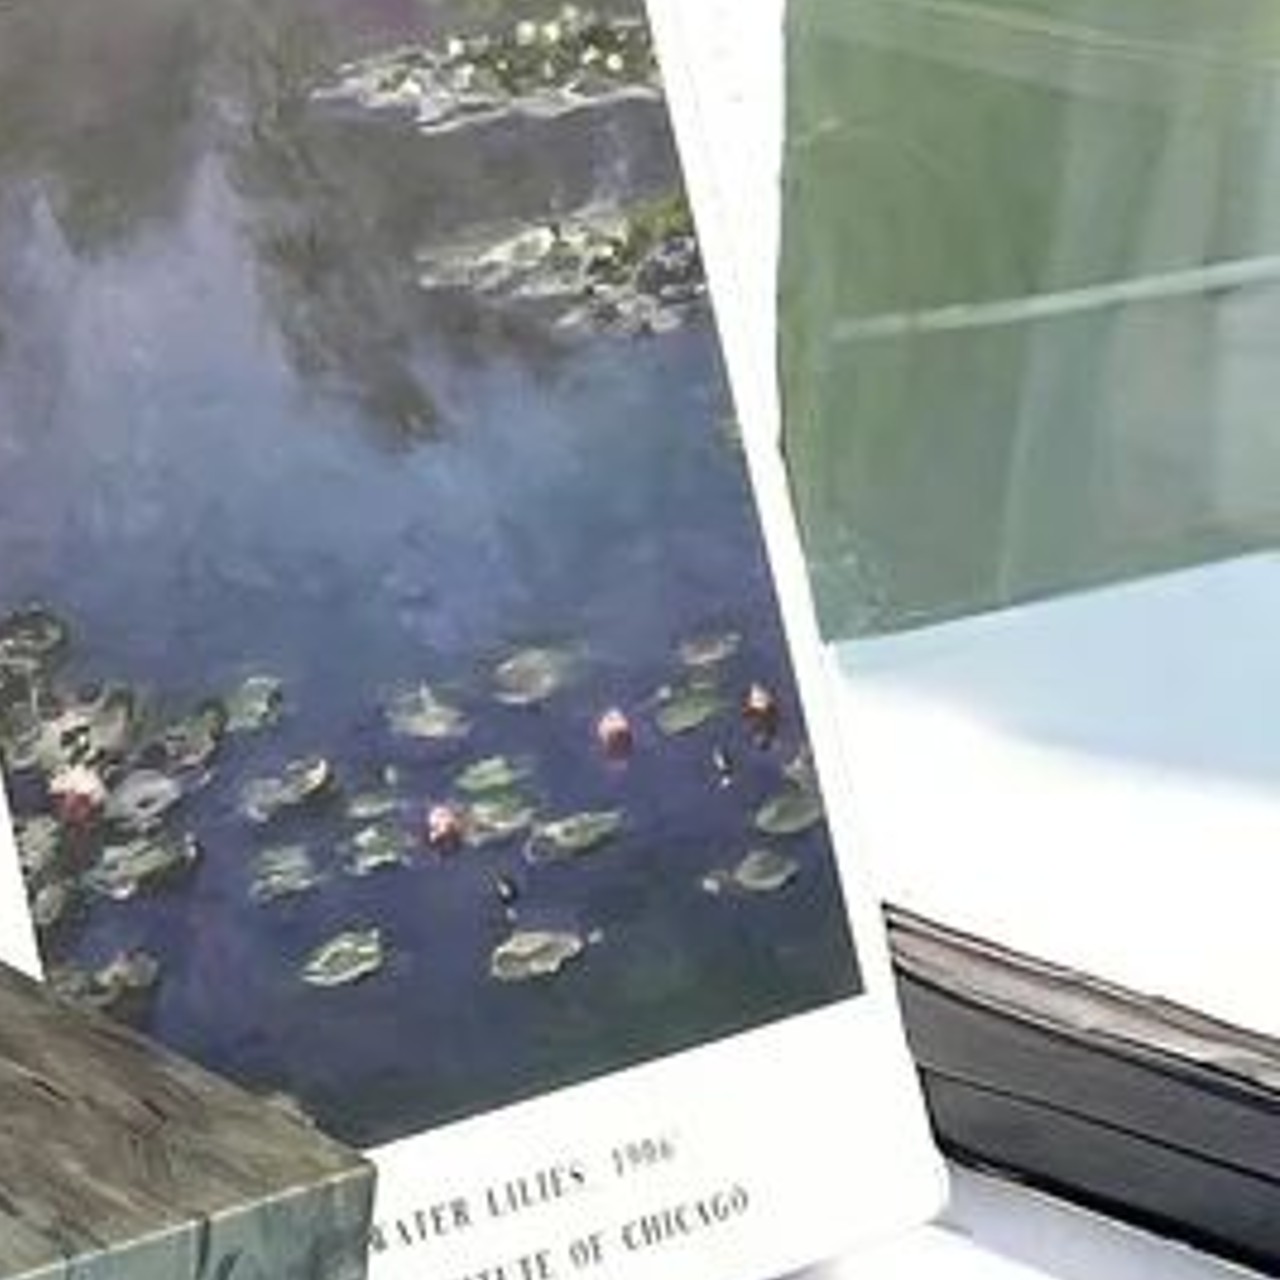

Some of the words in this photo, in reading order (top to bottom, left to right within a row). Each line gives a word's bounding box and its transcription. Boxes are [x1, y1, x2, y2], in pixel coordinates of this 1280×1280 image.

[487, 1161, 586, 1221] LILIES
[569, 1231, 606, 1271] OF
[621, 1186, 750, 1254] CHICAGO
